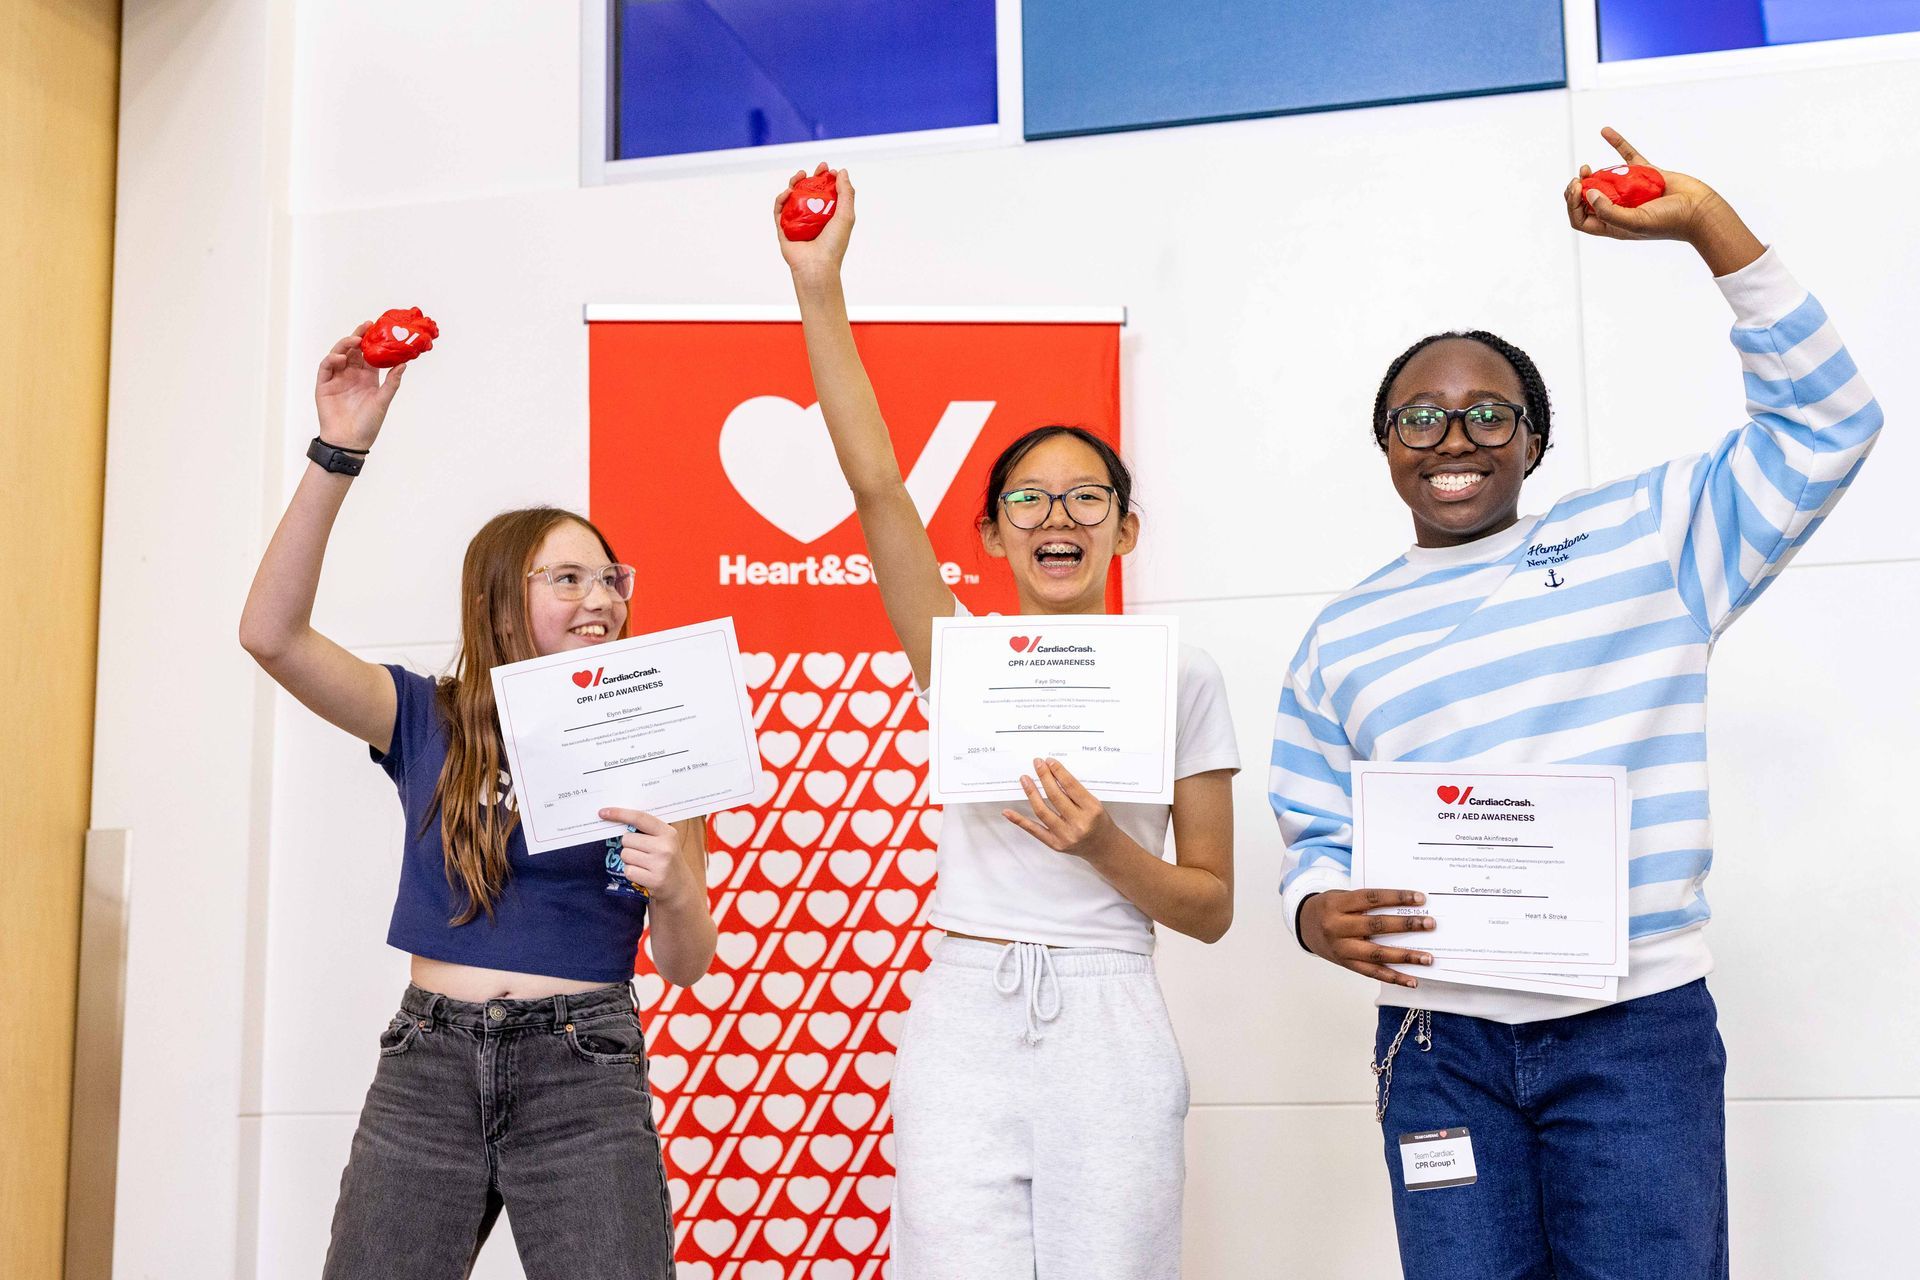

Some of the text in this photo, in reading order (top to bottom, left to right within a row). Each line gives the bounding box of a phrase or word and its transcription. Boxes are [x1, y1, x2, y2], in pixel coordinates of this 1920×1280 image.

[1527, 533, 1589, 556] Hamptons
[1527, 553, 1570, 568] New York
[719, 554, 962, 585] Heart&Se
[1037, 645, 1093, 653] CardiacCrash
[602, 667, 658, 685] CardiacCrash
[576, 695, 594, 705] CPR
[598, 691, 615, 700] AED
[615, 680, 664, 697] AWARENESS
[647, 749, 665, 758] School
[558, 788, 588, 799] 2025-10-14
[1469, 797, 1531, 807] CardiacCrash
[1438, 812, 1456, 820] CPR
[1481, 813, 1535, 822] AWARENESS
[1470, 886, 1501, 894] Centennial
[1502, 887, 1522, 895] School
[1414, 1150, 1455, 1160] Team Cardiac
[1415, 1158, 1456, 1170] CPR Group 1
